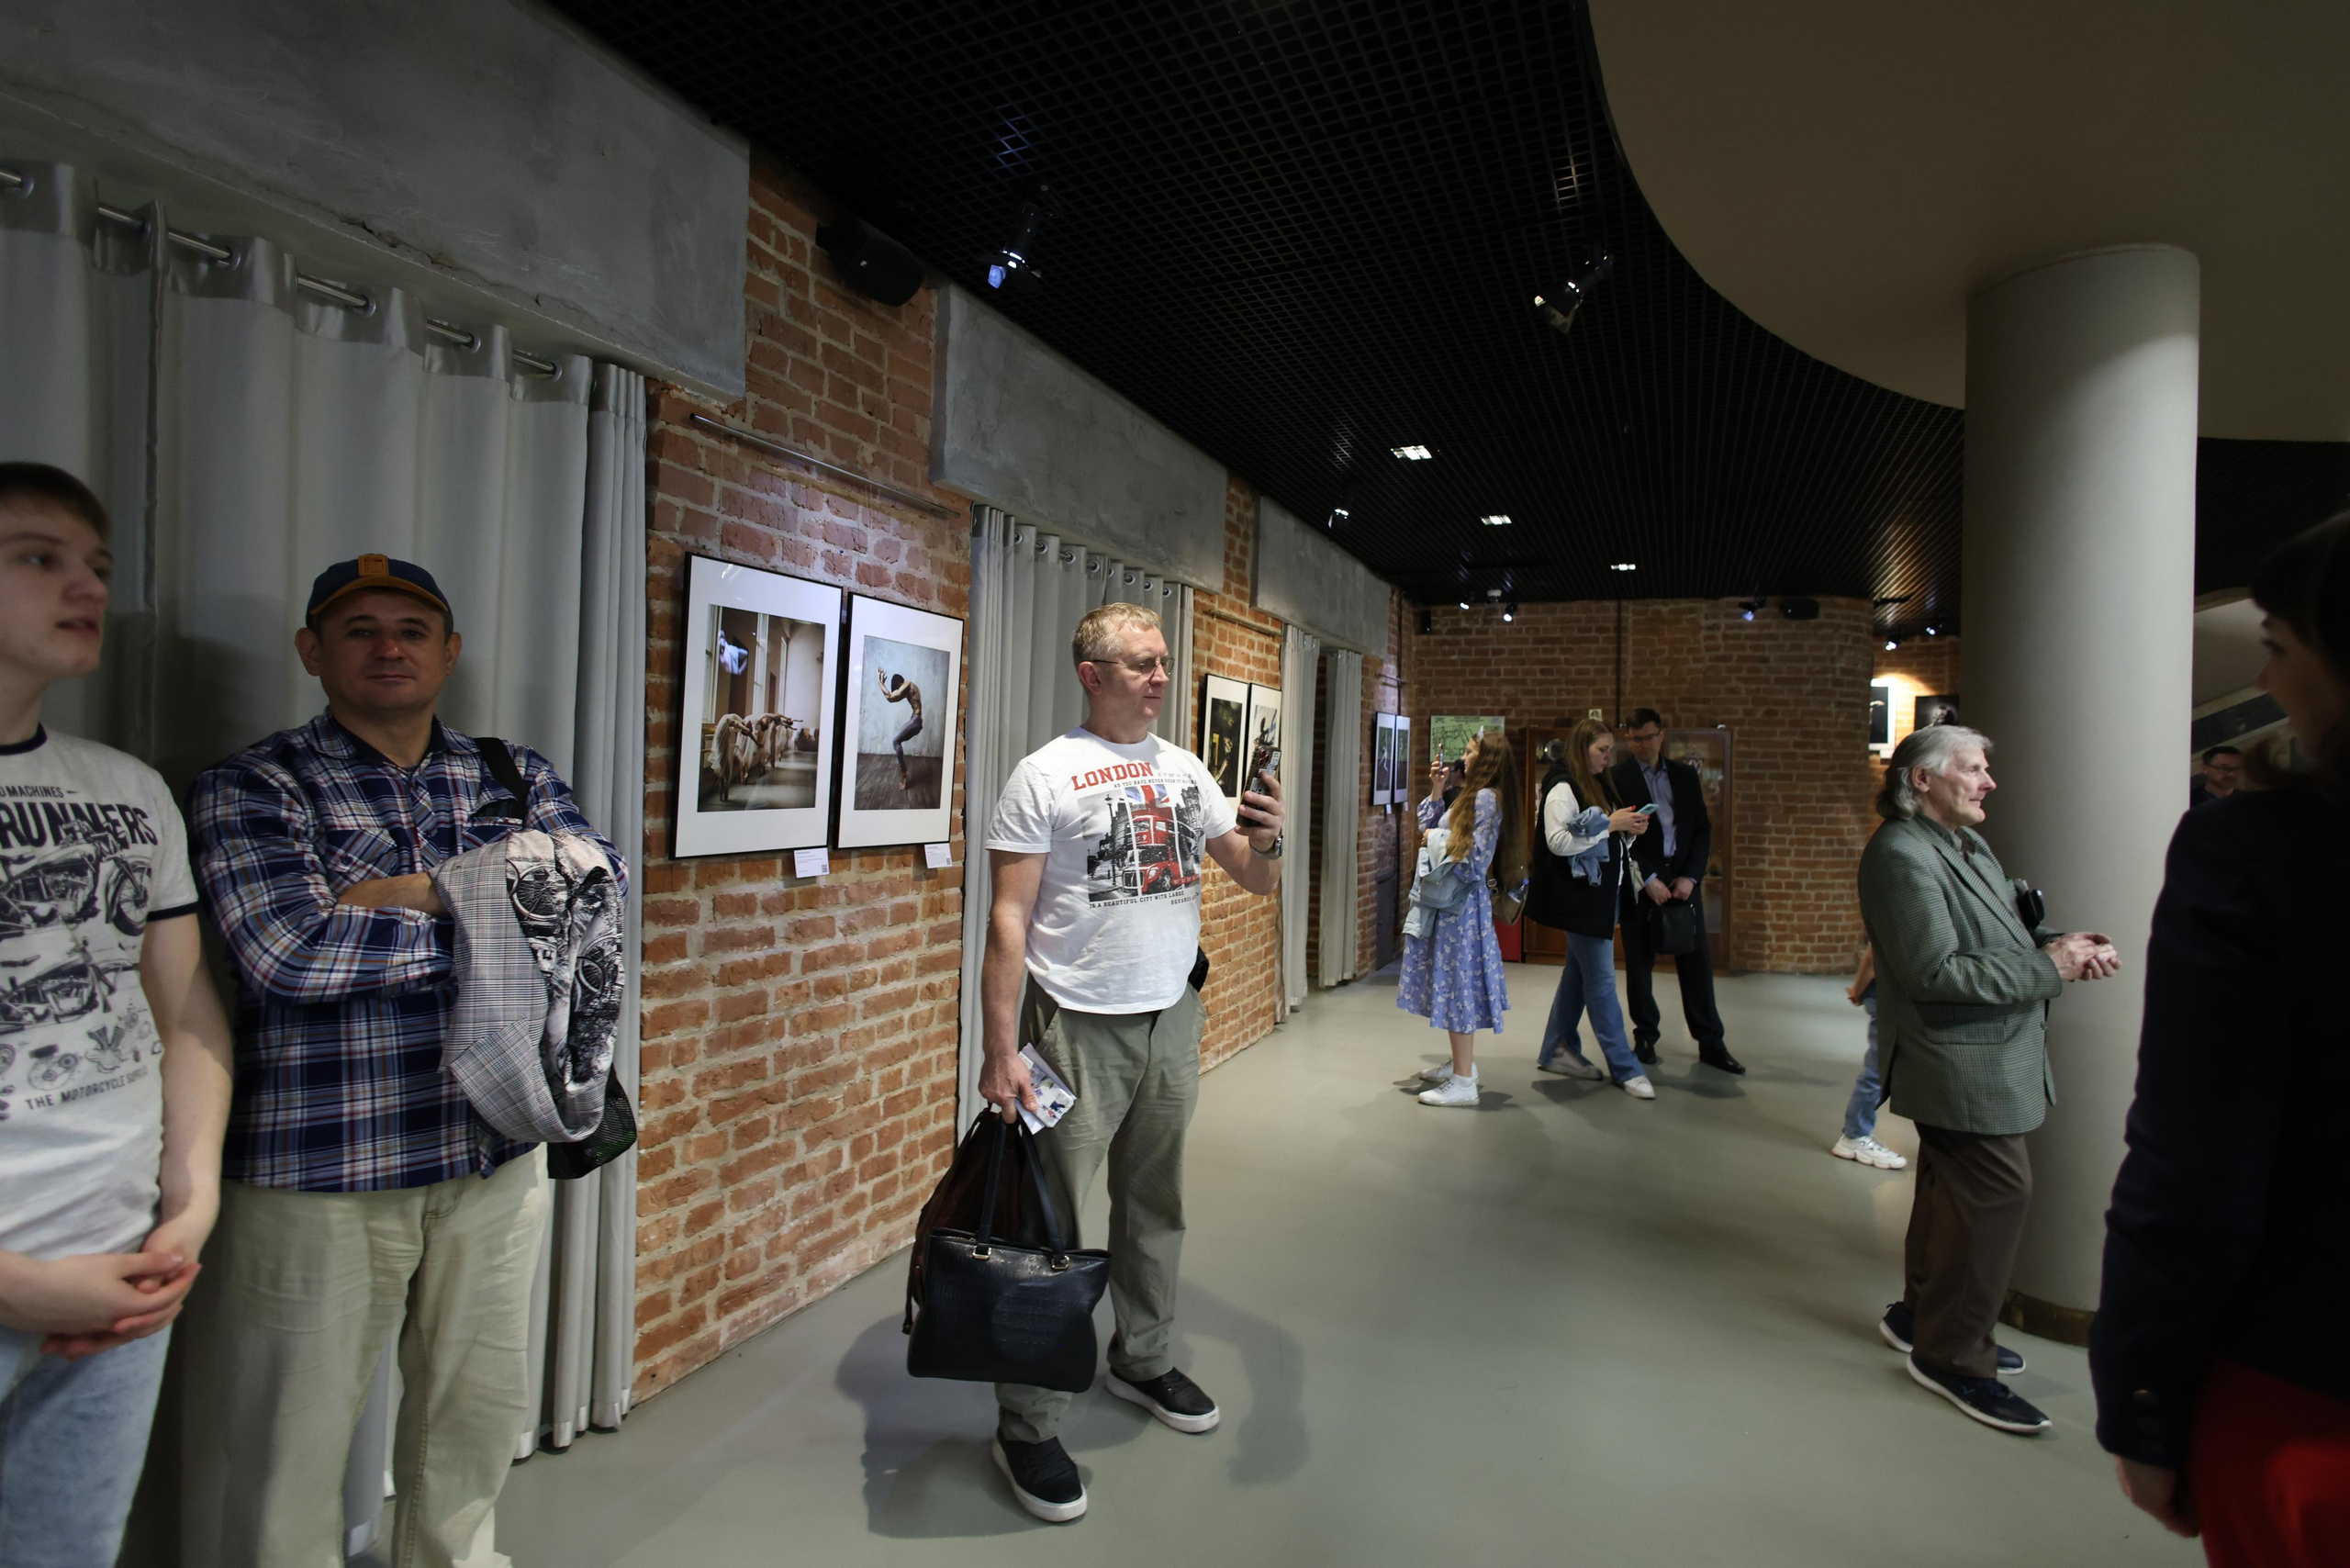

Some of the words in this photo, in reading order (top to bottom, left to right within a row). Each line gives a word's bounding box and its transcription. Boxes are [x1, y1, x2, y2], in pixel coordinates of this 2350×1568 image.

[1071, 762, 1153, 790] LONDON
[6, 786, 64, 798] MACHINES
[25, 1094, 54, 1110] THE
[61, 1075, 125, 1102] MOTORCYCLE
